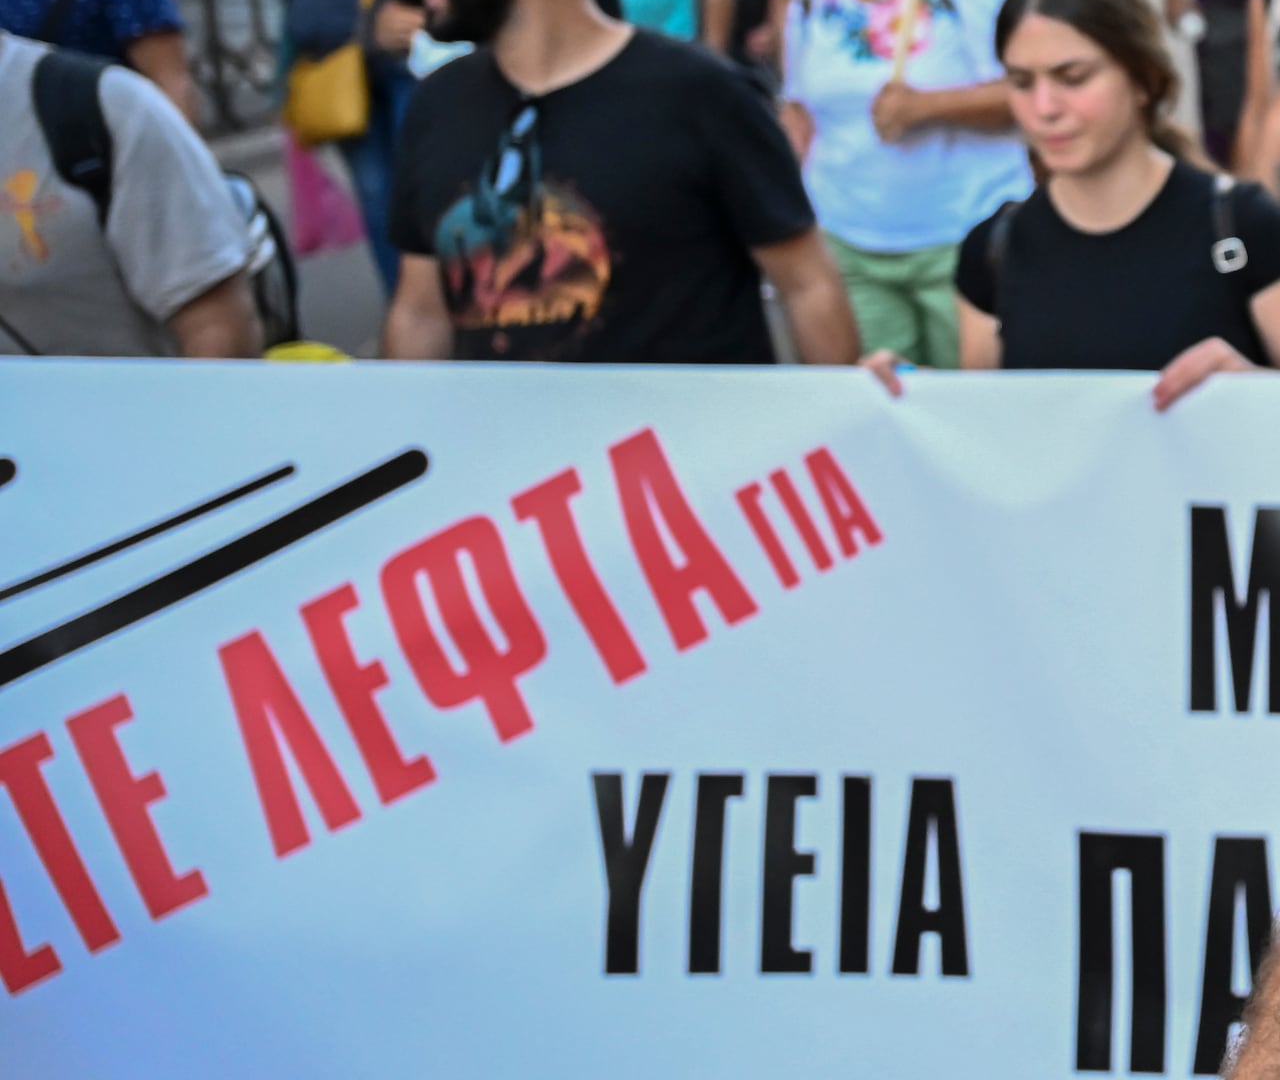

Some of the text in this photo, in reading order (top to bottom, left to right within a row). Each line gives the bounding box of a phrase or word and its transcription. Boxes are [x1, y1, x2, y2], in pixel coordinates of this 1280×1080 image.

[219, 427, 759, 858] ΛΕΦΤΑ
[735, 446, 883, 590] ΓΙΑ
[592, 774, 970, 977] ΥΓΕΙΑ
